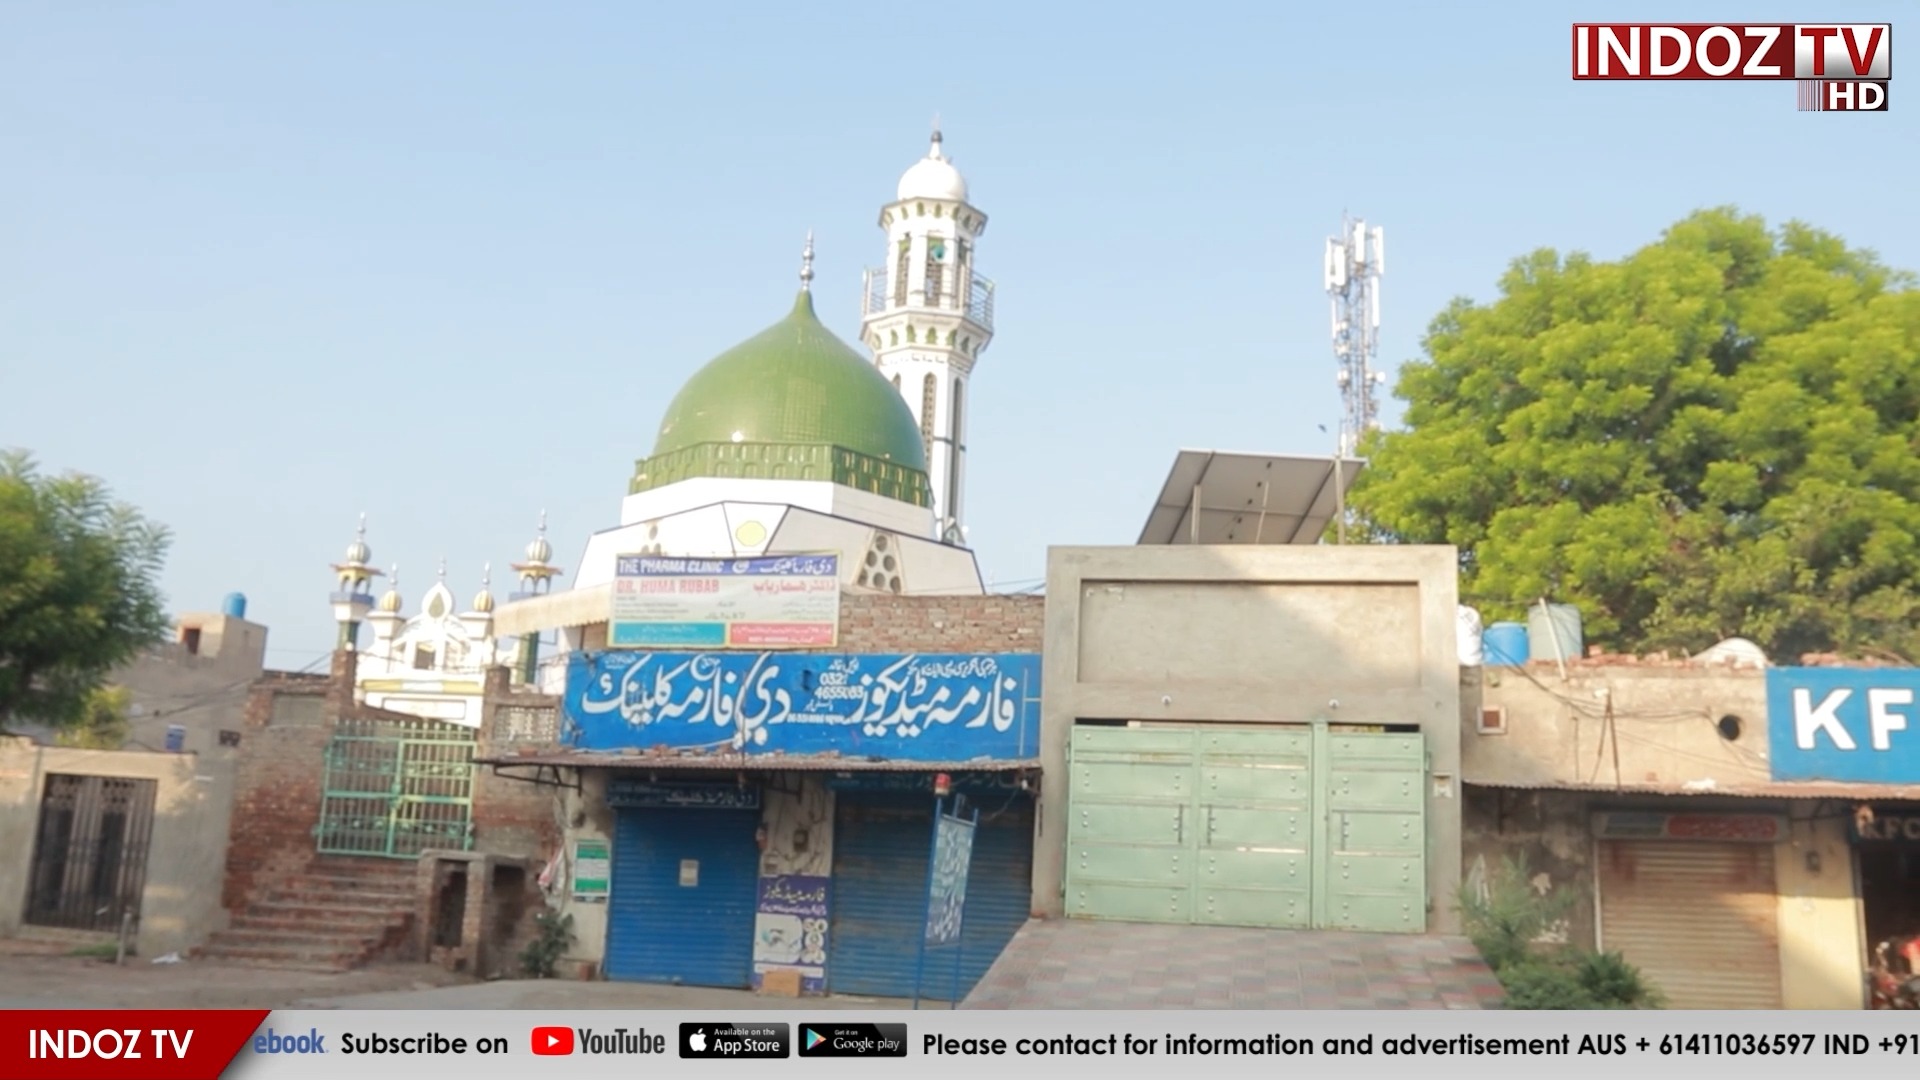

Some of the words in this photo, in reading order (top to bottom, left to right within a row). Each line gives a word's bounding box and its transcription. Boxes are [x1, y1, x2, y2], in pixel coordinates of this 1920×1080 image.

[620, 559, 639, 573] THE
[640, 559, 685, 574] PHARMA
[687, 560, 725, 574] CLINIC
[641, 579, 676, 594] HUMA
[680, 579, 720, 594] RUBAB
